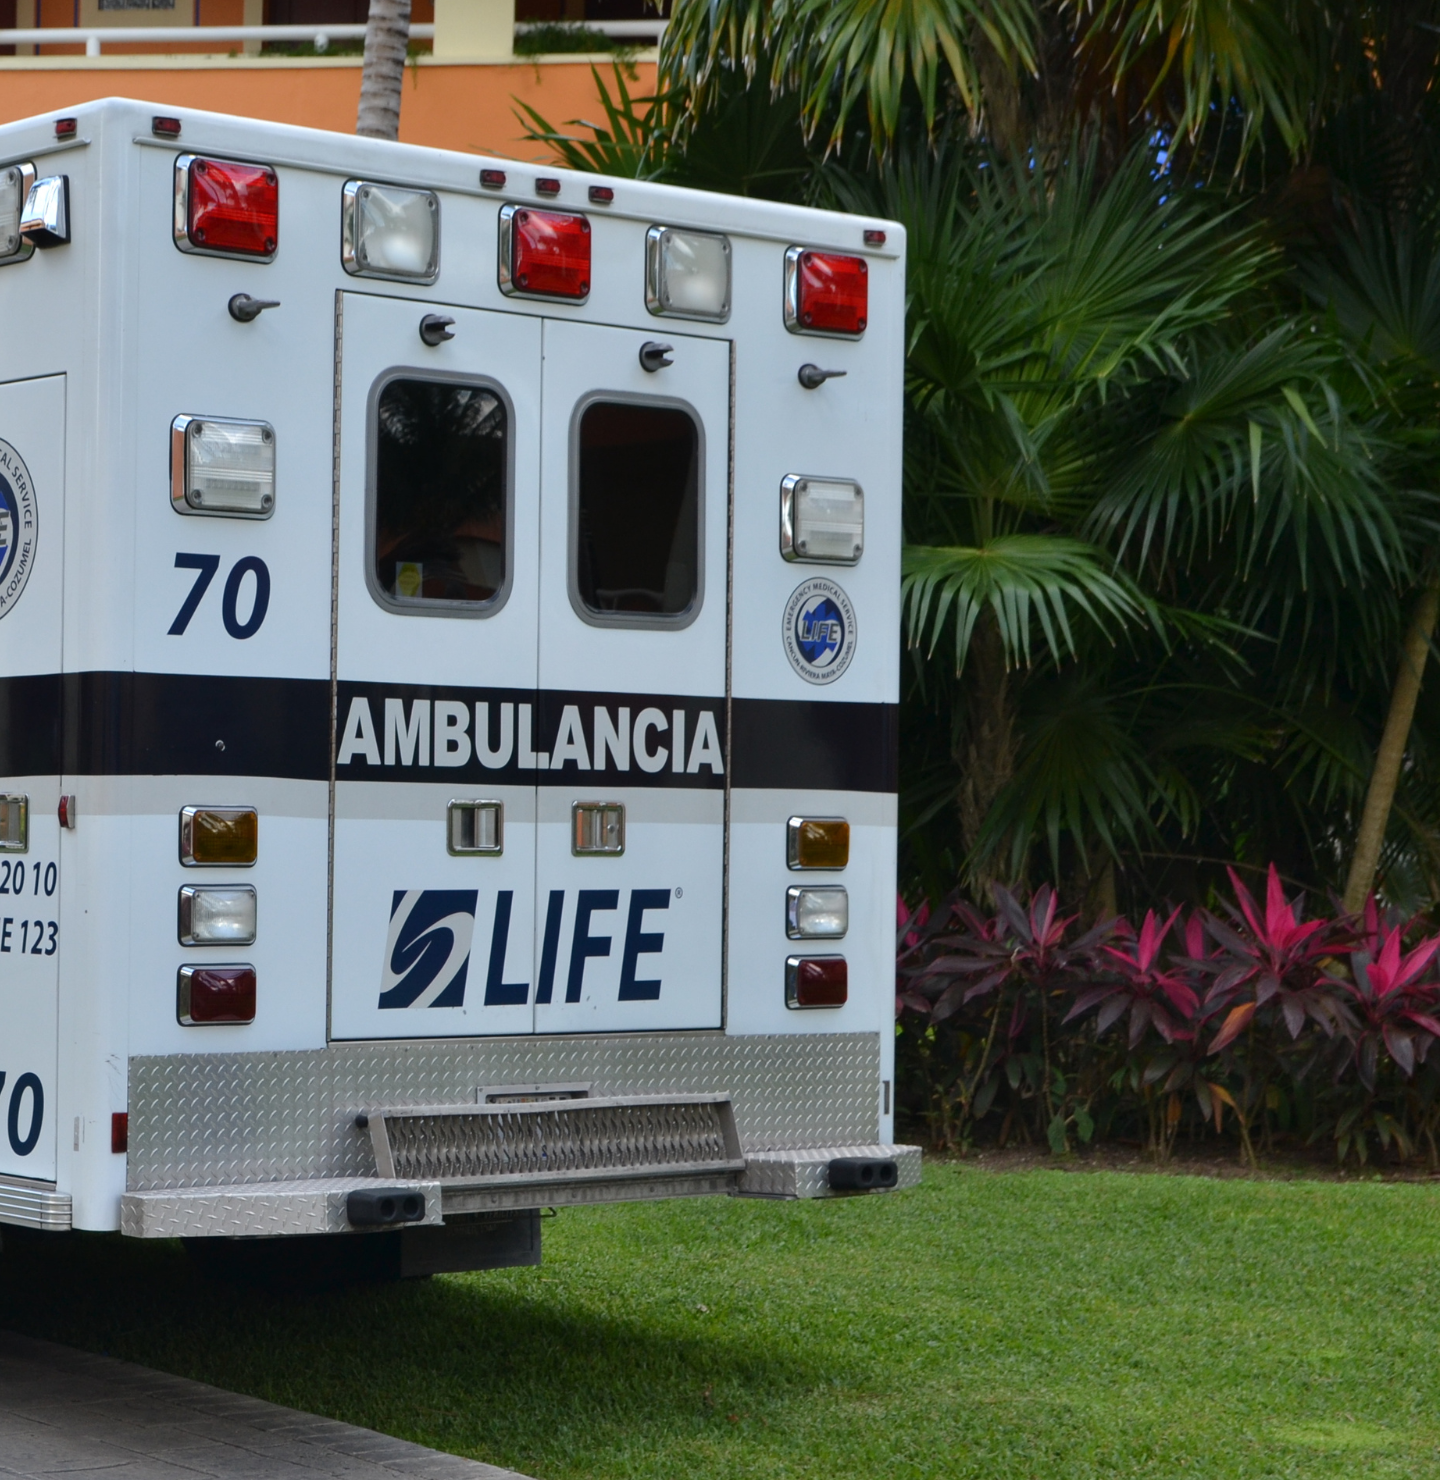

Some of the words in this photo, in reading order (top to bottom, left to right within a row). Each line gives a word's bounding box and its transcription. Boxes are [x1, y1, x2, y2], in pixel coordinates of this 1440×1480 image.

[11, 466, 33, 530] SERVICE
[166, 551, 271, 640] 70
[786, 585, 812, 631] EMERGENCY
[812, 582, 841, 601] MEDICAL
[840, 599, 854, 636] SERVICE
[800, 620, 840, 643] LIFE
[336, 697, 725, 775] AMBULANCIA
[32, 861, 58, 897] 10
[20, 919, 59, 956] 123
[483, 889, 671, 1006] LIFE
